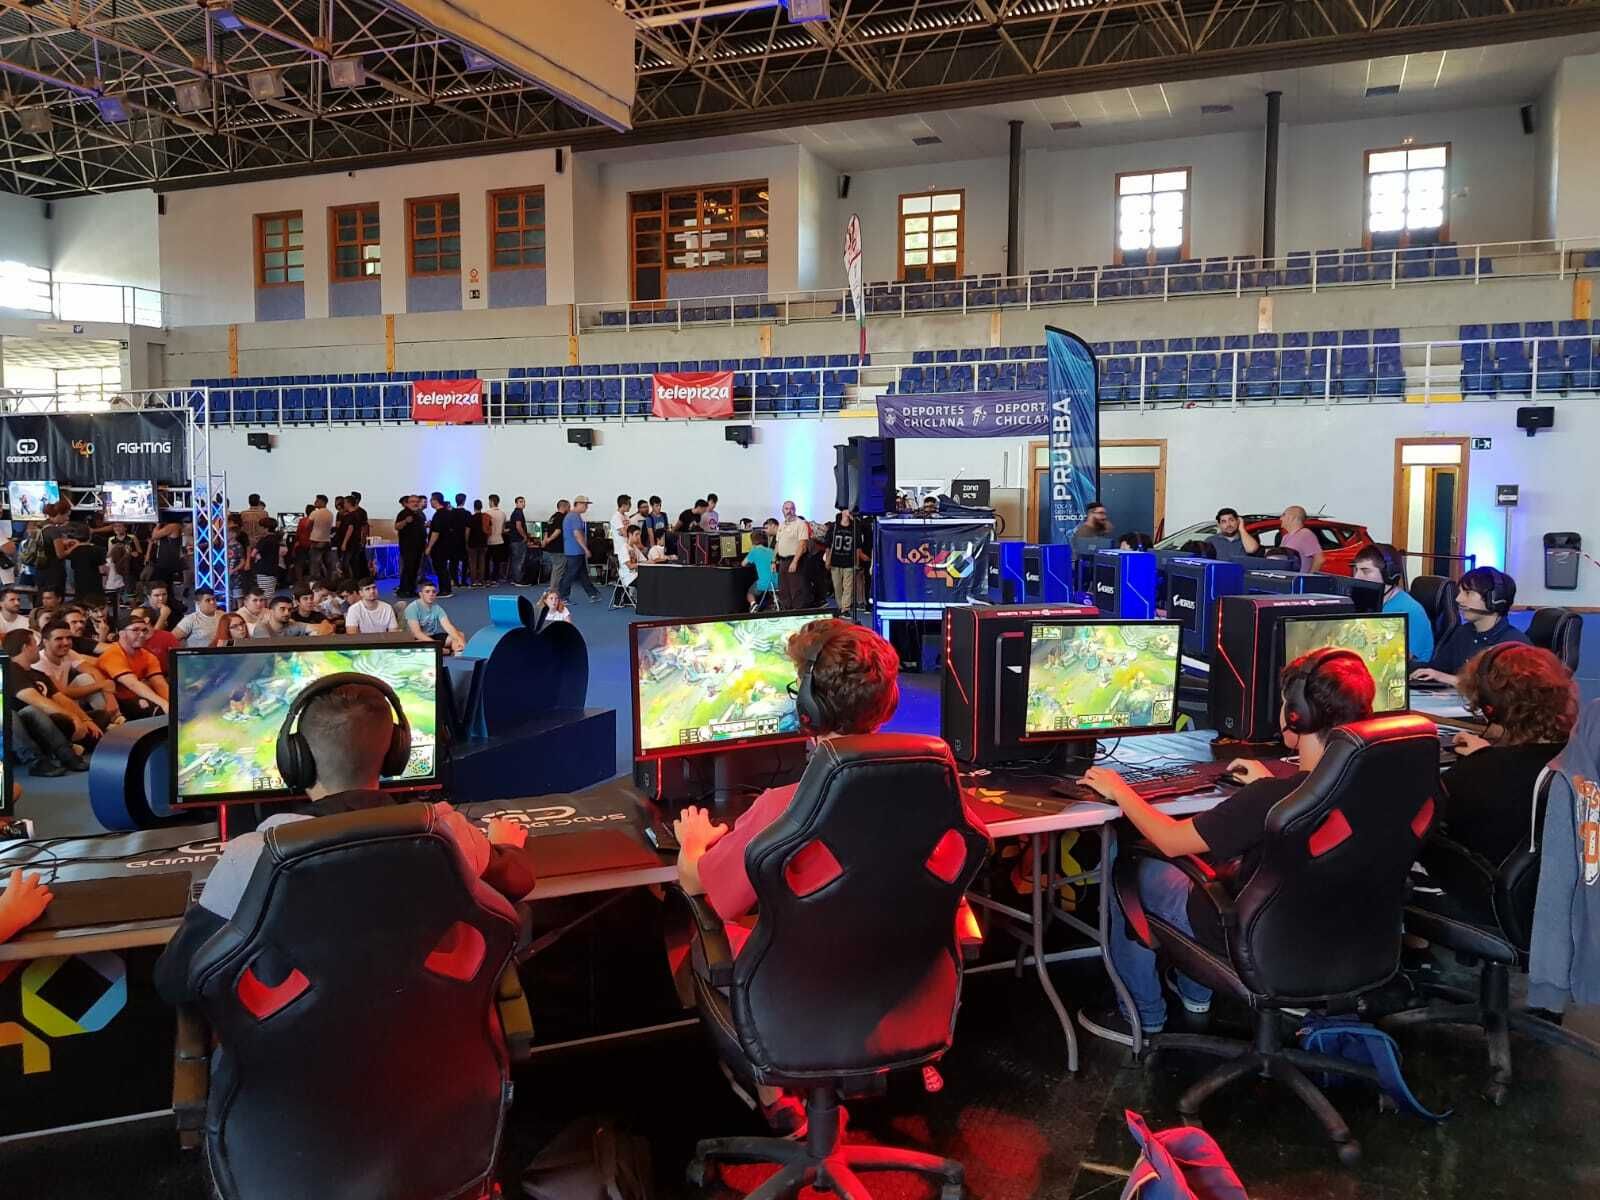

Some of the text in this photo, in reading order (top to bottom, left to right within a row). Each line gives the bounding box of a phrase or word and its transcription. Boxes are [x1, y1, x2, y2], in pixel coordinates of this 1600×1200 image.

[416, 391, 479, 410] telepizza
[657, 385, 729, 405] telepizza
[902, 405, 964, 417] DEPORTES
[995, 402, 1047, 414] DEPORT
[903, 417, 964, 428] CHICLANA
[995, 415, 1049, 426] CHICLAN
[116, 442, 171, 454] FIGHTING
[1052, 397, 1072, 501] PRUEBA
[835, 535, 853, 550] 03
